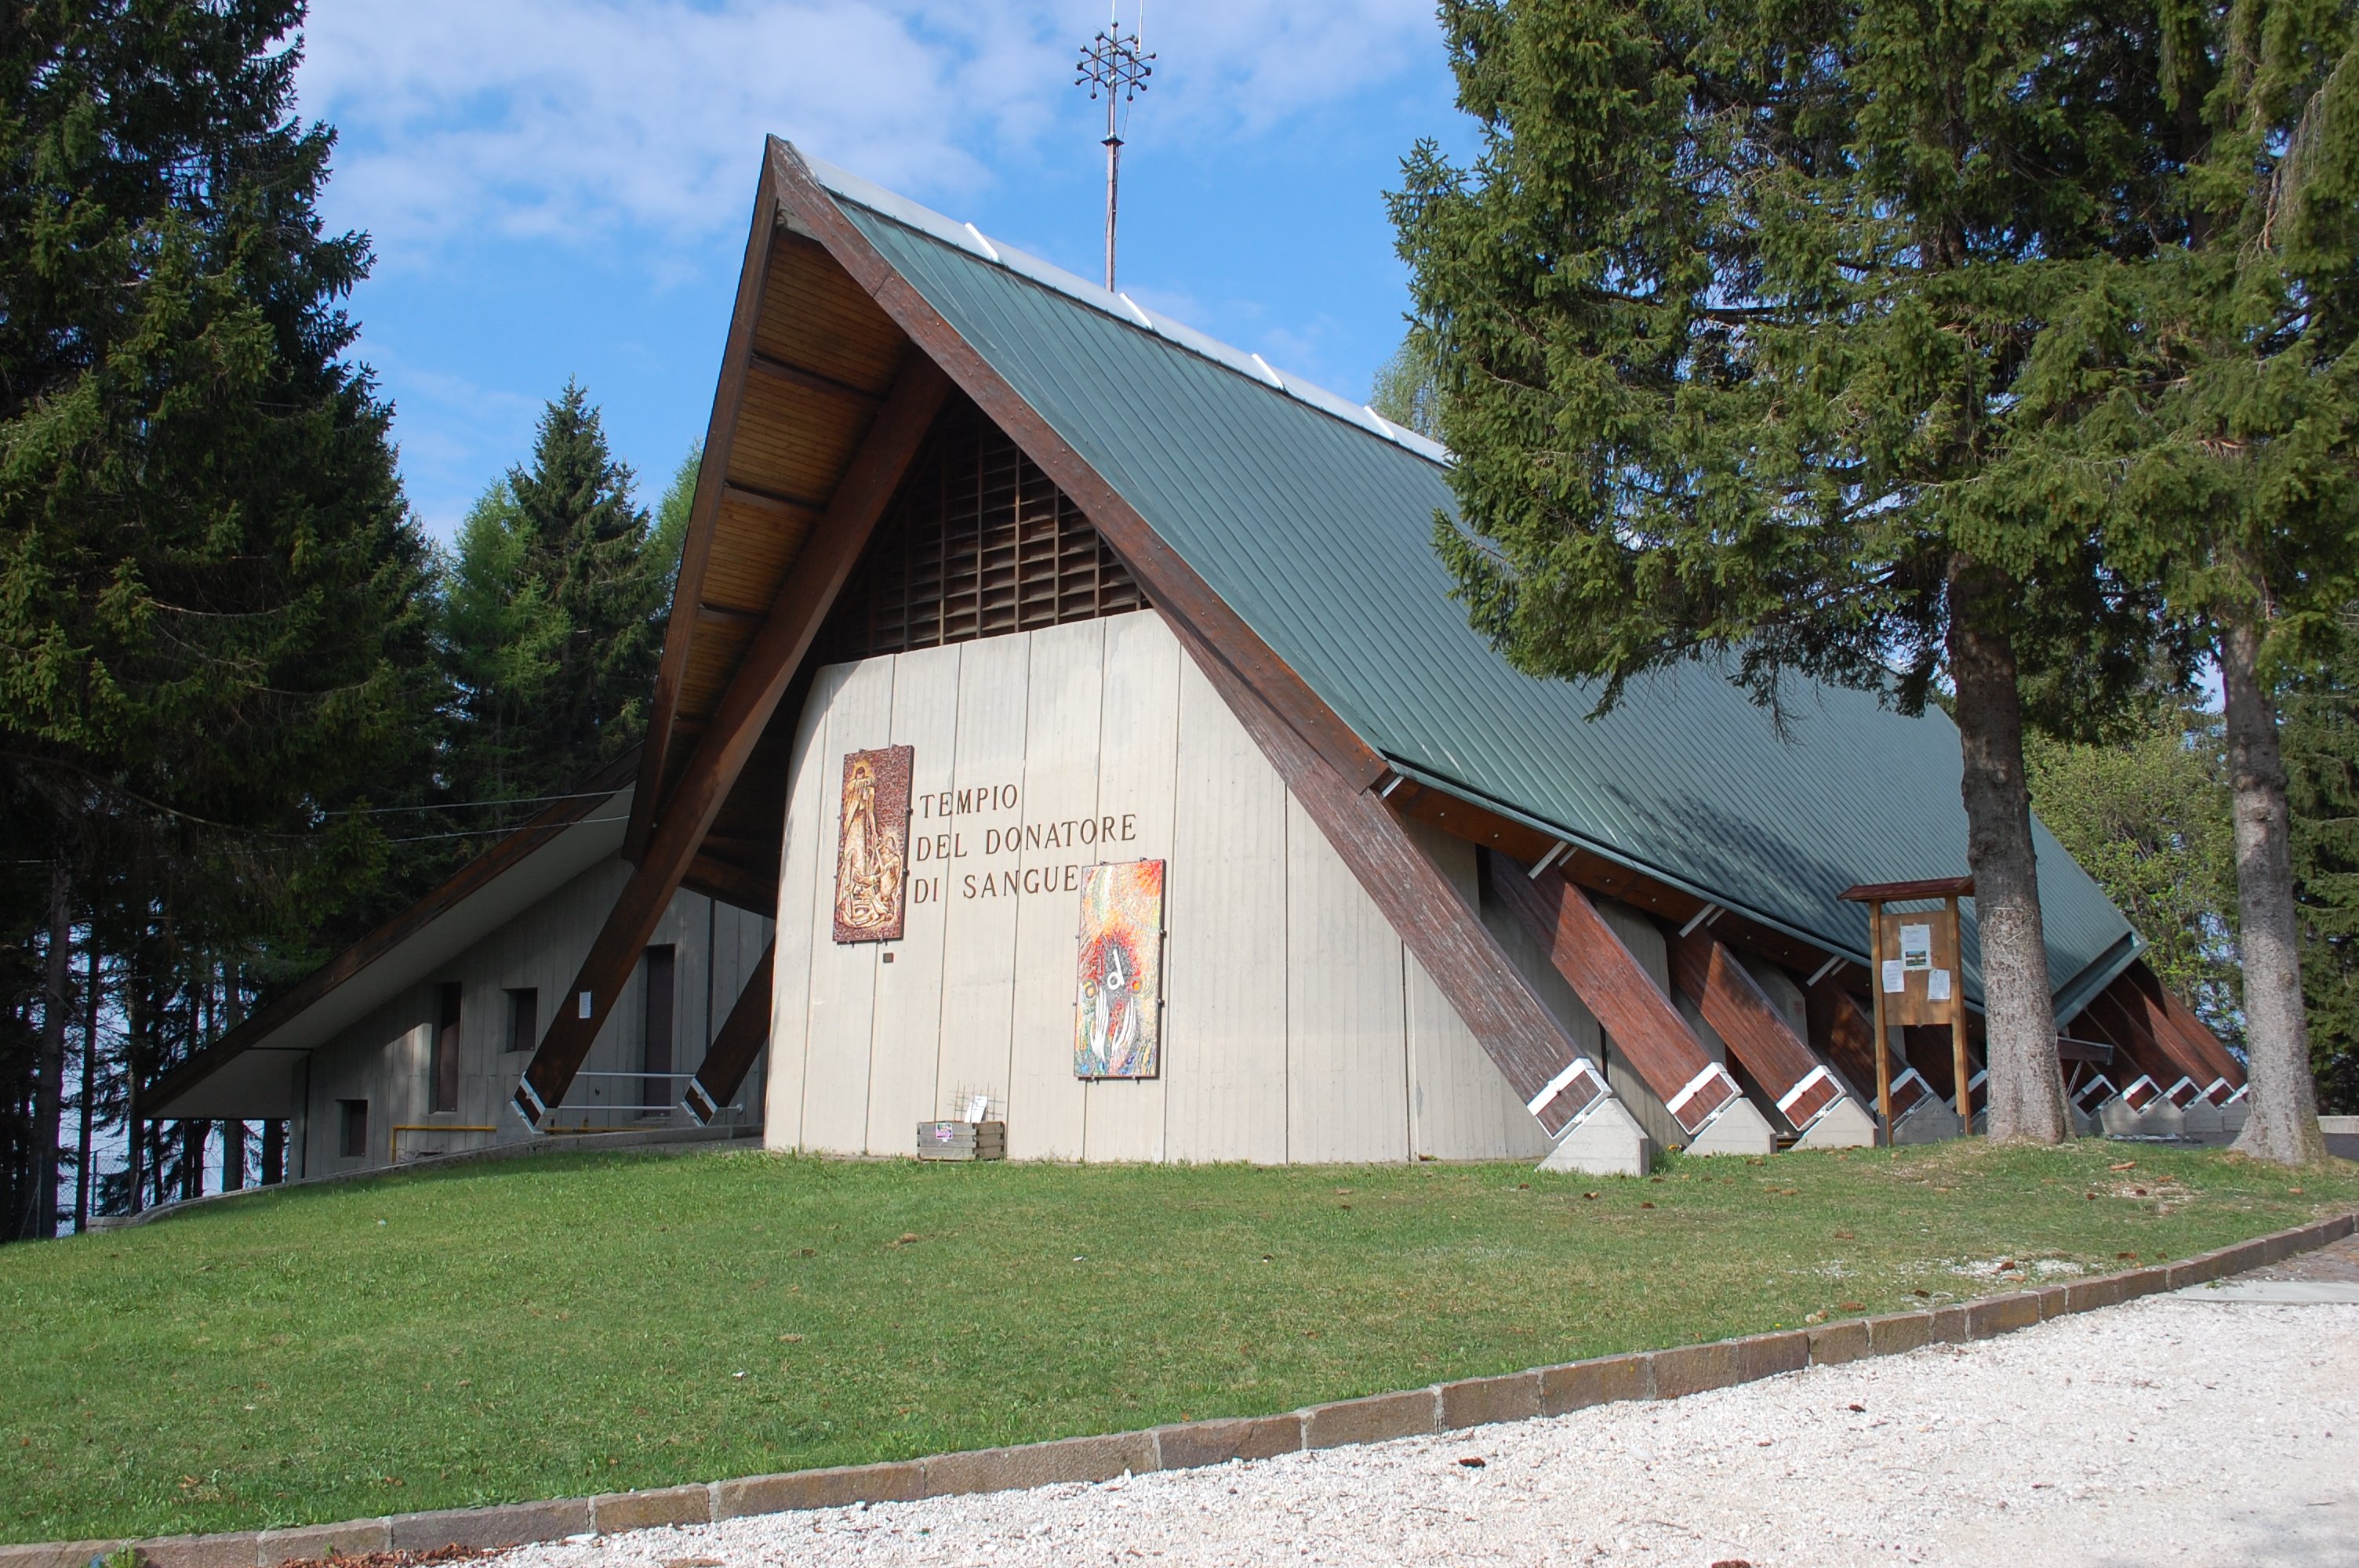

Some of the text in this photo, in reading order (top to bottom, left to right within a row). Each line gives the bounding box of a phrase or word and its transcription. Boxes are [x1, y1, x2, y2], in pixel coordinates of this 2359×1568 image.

[919, 784, 1018, 818] TEMPIO
[917, 815, 1136, 862] DEL DONATORE
[914, 865, 1078, 904] DI SANGUE
